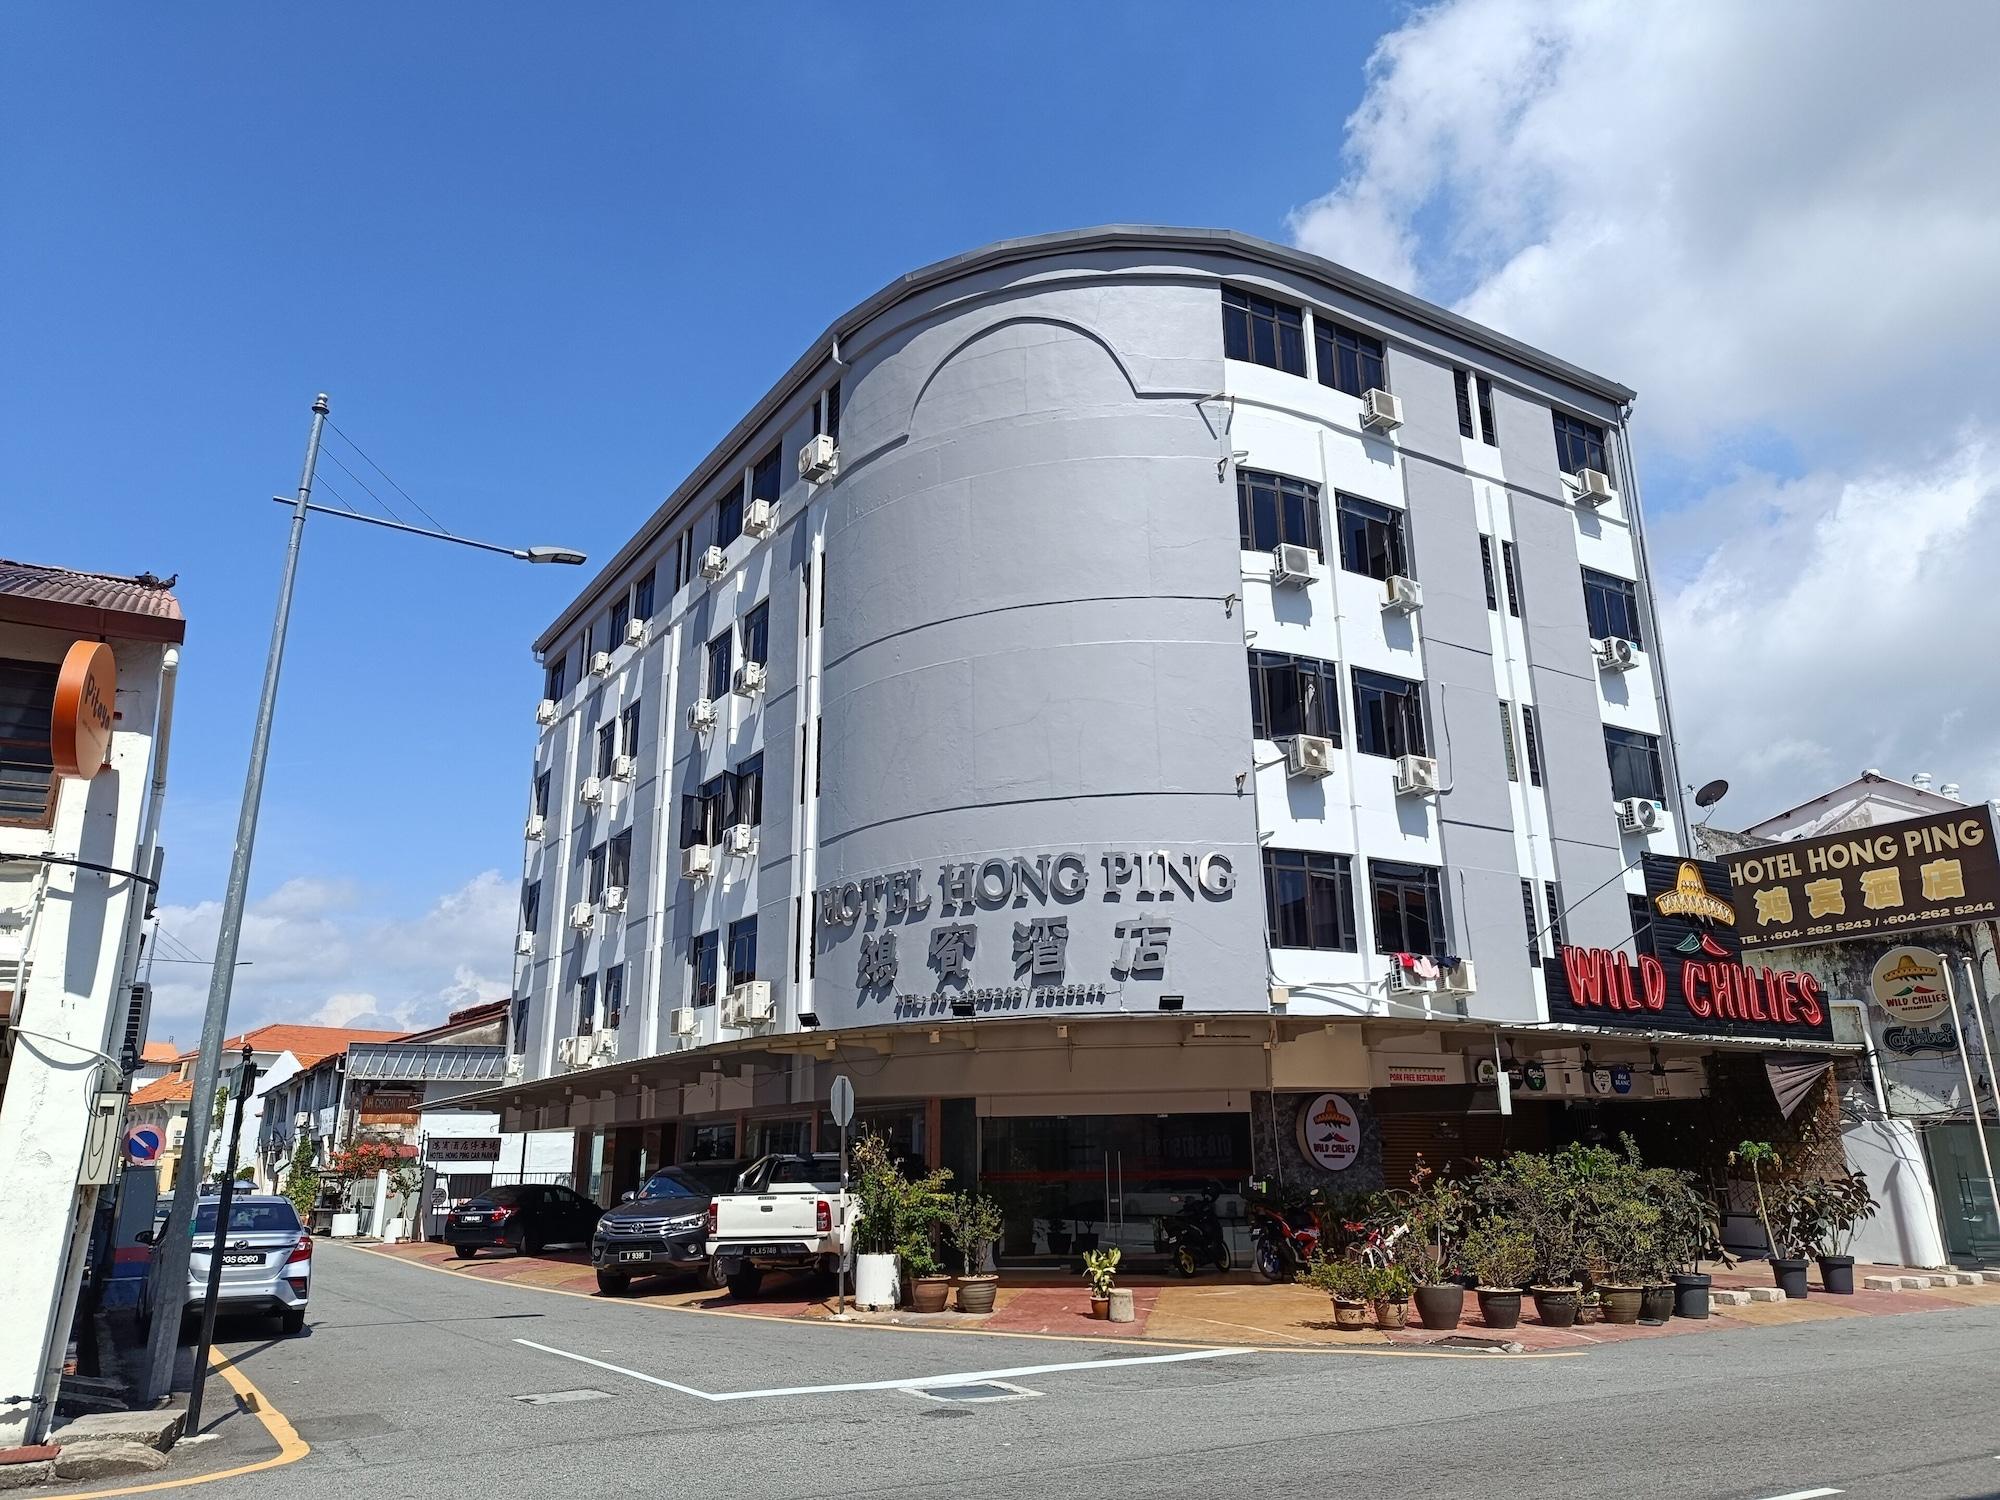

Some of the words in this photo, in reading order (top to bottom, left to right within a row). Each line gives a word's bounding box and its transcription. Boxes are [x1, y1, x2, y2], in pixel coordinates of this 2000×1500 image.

[85, 673, 110, 731] Pitaya
[1729, 852, 1802, 887] HOTEL
[1807, 835, 1899, 874] HONG
[1903, 819, 1985, 857] PING
[818, 868, 932, 927] HOTEL
[939, 853, 1089, 904] HONG
[1102, 850, 1237, 895] PING
[1806, 924, 1834, 935] 262
[1836, 919, 1872, 932] 5243
[1954, 901, 1996, 916] 5244
[1562, 944, 1667, 1011] WILD
[1681, 959, 1825, 1028] CHILIES
[1886, 997, 1909, 1008] WILD
[1912, 993, 1948, 1005] CHILIES
[1885, 1024, 1962, 1053] Carlsber
[1389, 1073, 1403, 1081] PORK
[1403, 1073, 1416, 1082] FREE
[1416, 1074, 1446, 1082] RESTAURANT
[430, 1151, 444, 1159] HOTEL
[445, 1151, 459, 1159] HONG
[459, 1151, 470, 1159] PING
[470, 1151, 481, 1159] CAR
[481, 1151, 494, 1159] PARK
[1313, 1143, 1330, 1153] WILD
[1331, 1144, 1356, 1153] CHILIES
[237, 1255, 259, 1264] 6260
